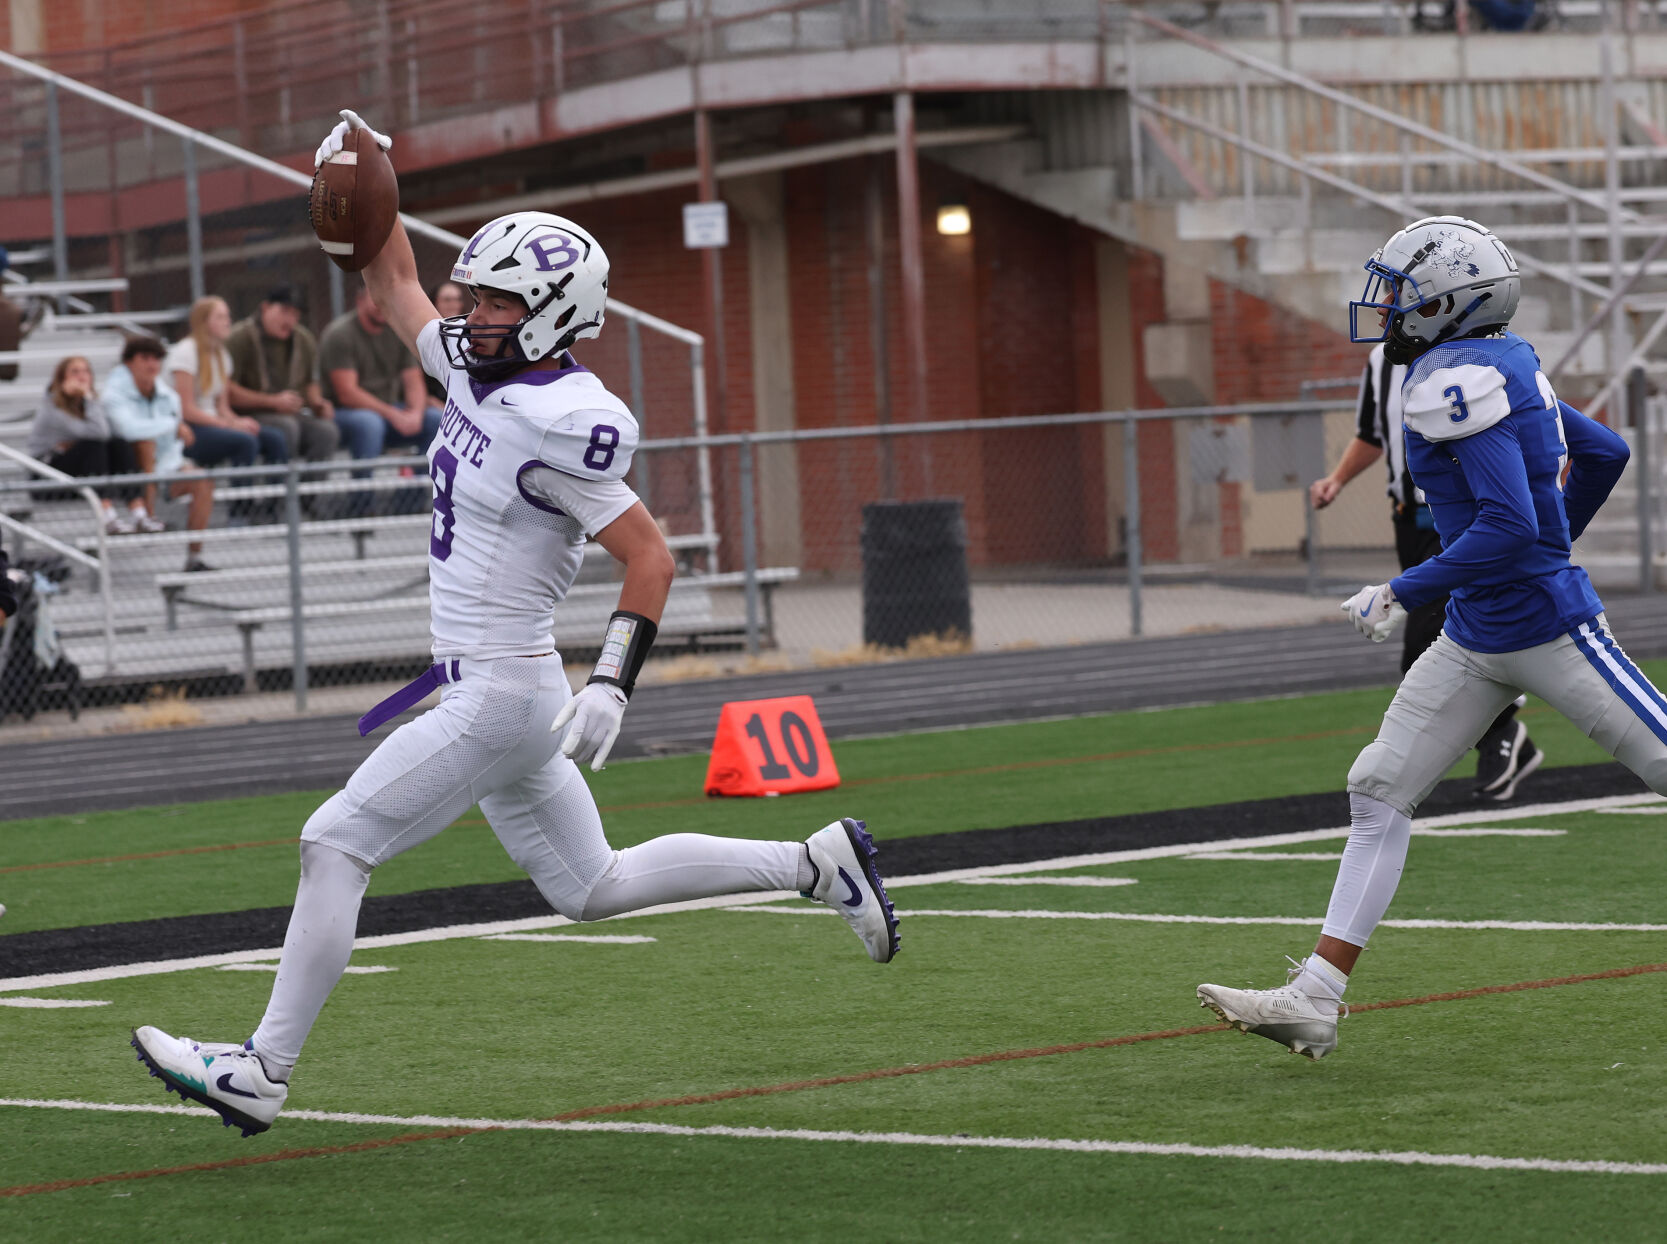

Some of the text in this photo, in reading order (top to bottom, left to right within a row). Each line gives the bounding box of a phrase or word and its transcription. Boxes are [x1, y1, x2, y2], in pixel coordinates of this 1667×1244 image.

[524, 234, 579, 272] B
[439, 397, 492, 469] BUTTE
[1443, 385, 1470, 424] 3
[583, 424, 619, 471] 8
[430, 446, 459, 562] 8
[744, 711, 820, 780] 10
